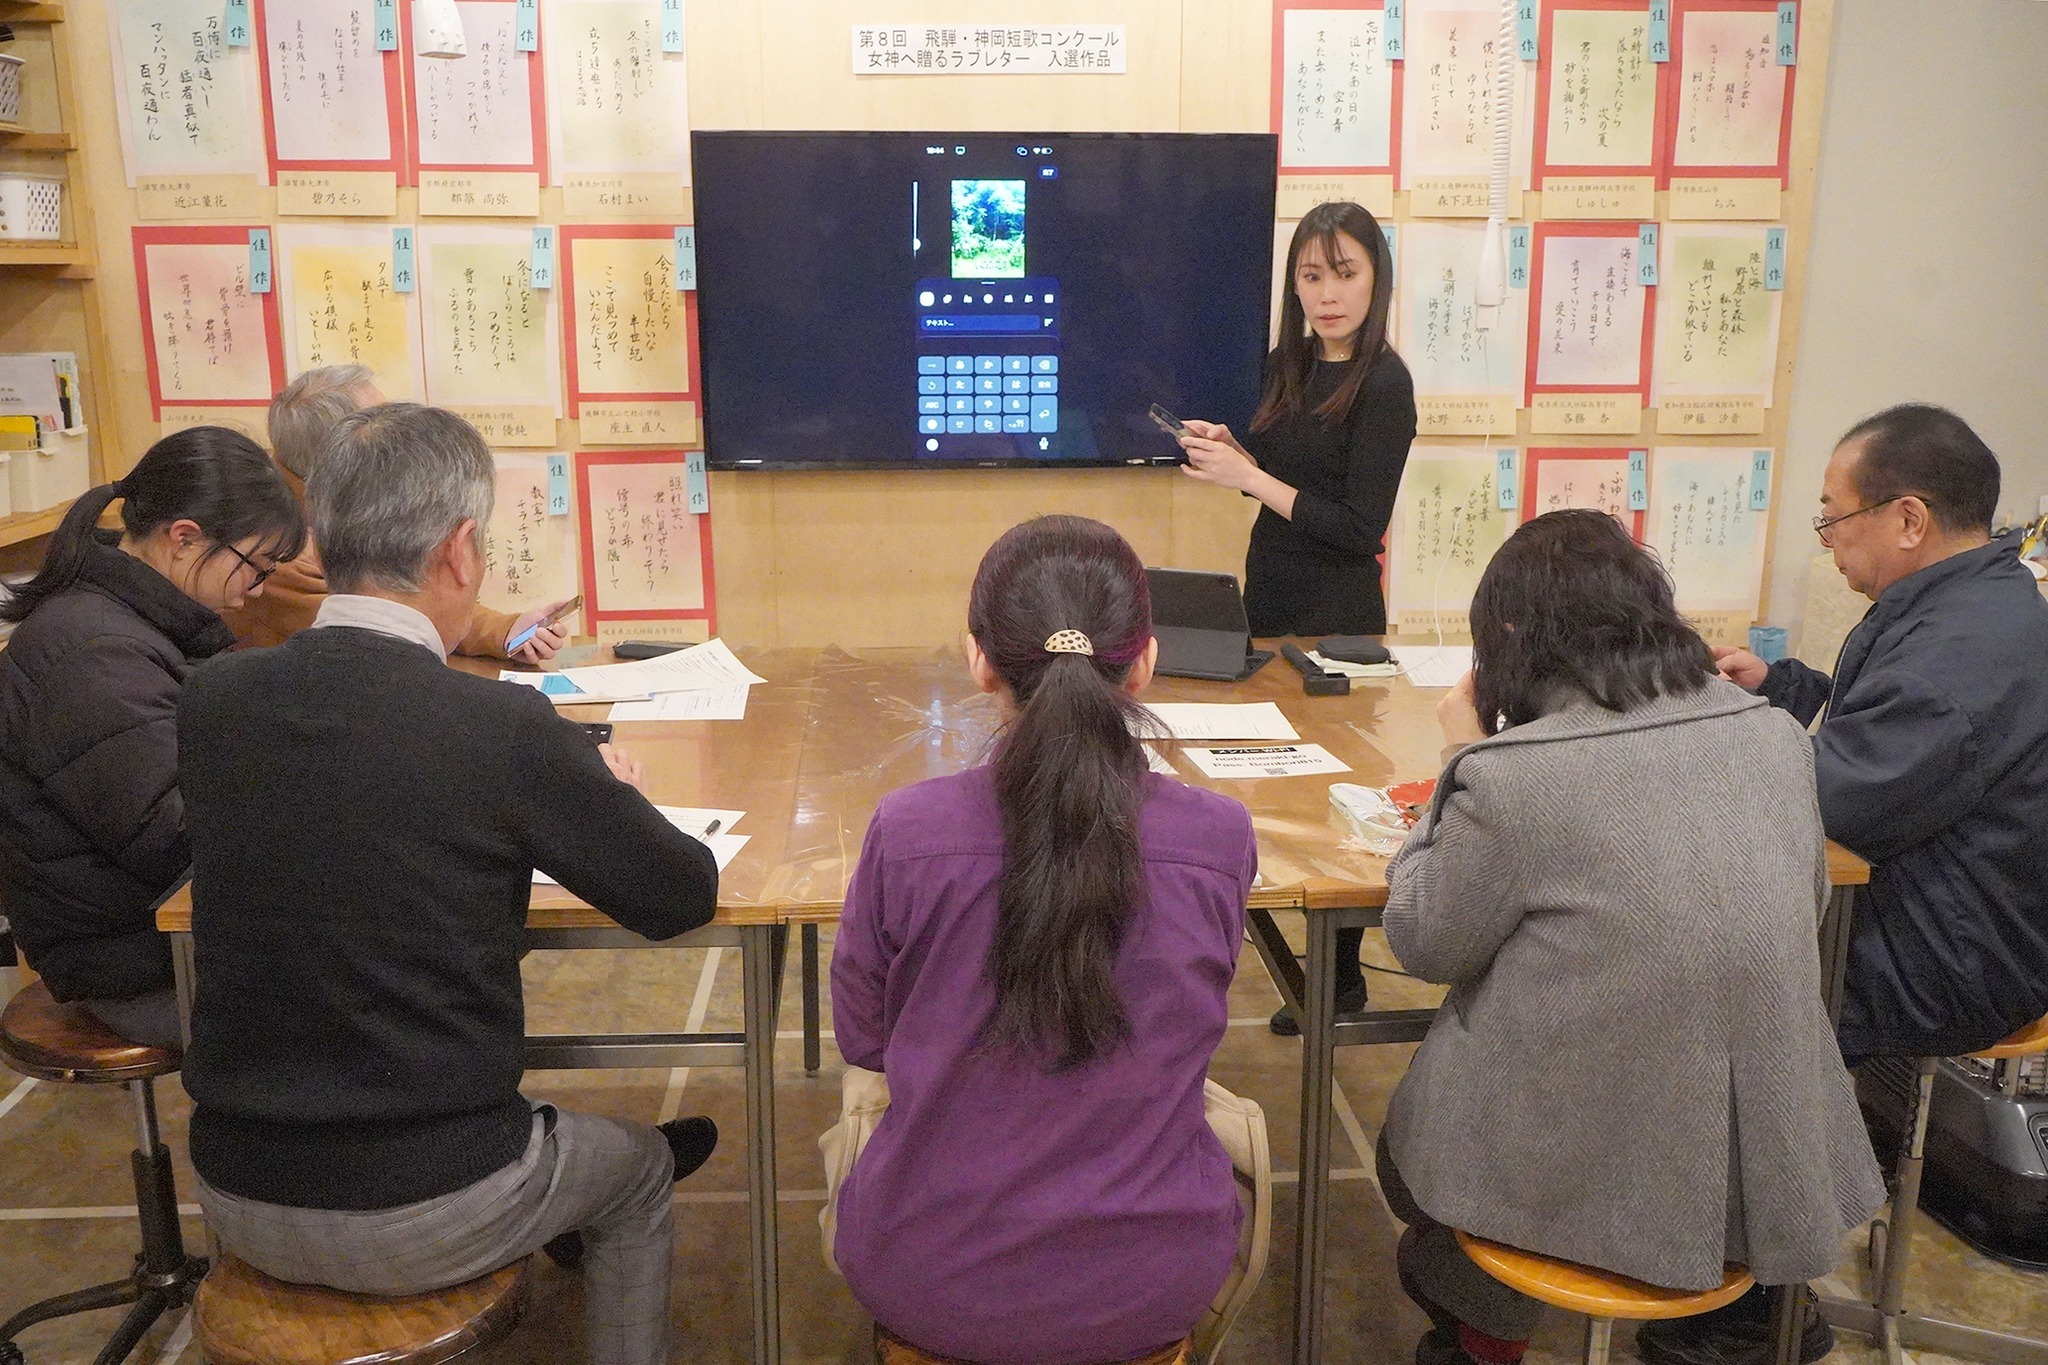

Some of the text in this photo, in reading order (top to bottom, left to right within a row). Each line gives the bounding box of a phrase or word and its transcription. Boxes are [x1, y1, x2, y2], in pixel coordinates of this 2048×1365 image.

[206, 16, 221, 60] 万博に
[665, 0, 680, 43] 佳作
[859, 29, 1120, 49] 第8回 飛騨・神岡短歌コンクール
[1387, 6, 1401, 52] 佳作
[1519, 7, 1535, 53] 佳作
[1652, 9, 1666, 54] 佳作
[1780, 10, 1793, 58] 佳作
[150, 22, 171, 101] マンハッタンに
[867, 49, 1112, 69] 女神へ贈るラブレター 入選作品
[252, 237, 268, 285] 佳作
[396, 237, 411, 284] 佳作
[535, 237, 550, 282] 佳作
[677, 236, 693, 282] 佳作
[1512, 236, 1526, 281] 佳作
[1641, 232, 1655, 279] 佳作
[1768, 236, 1782, 282] 佳作
[550, 460, 566, 509] 佳作
[688, 460, 706, 505] 佳作
[1500, 457, 1514, 500] 佳作
[1630, 459, 1644, 502] 佳作
[1754, 459, 1767, 502] 佳作
